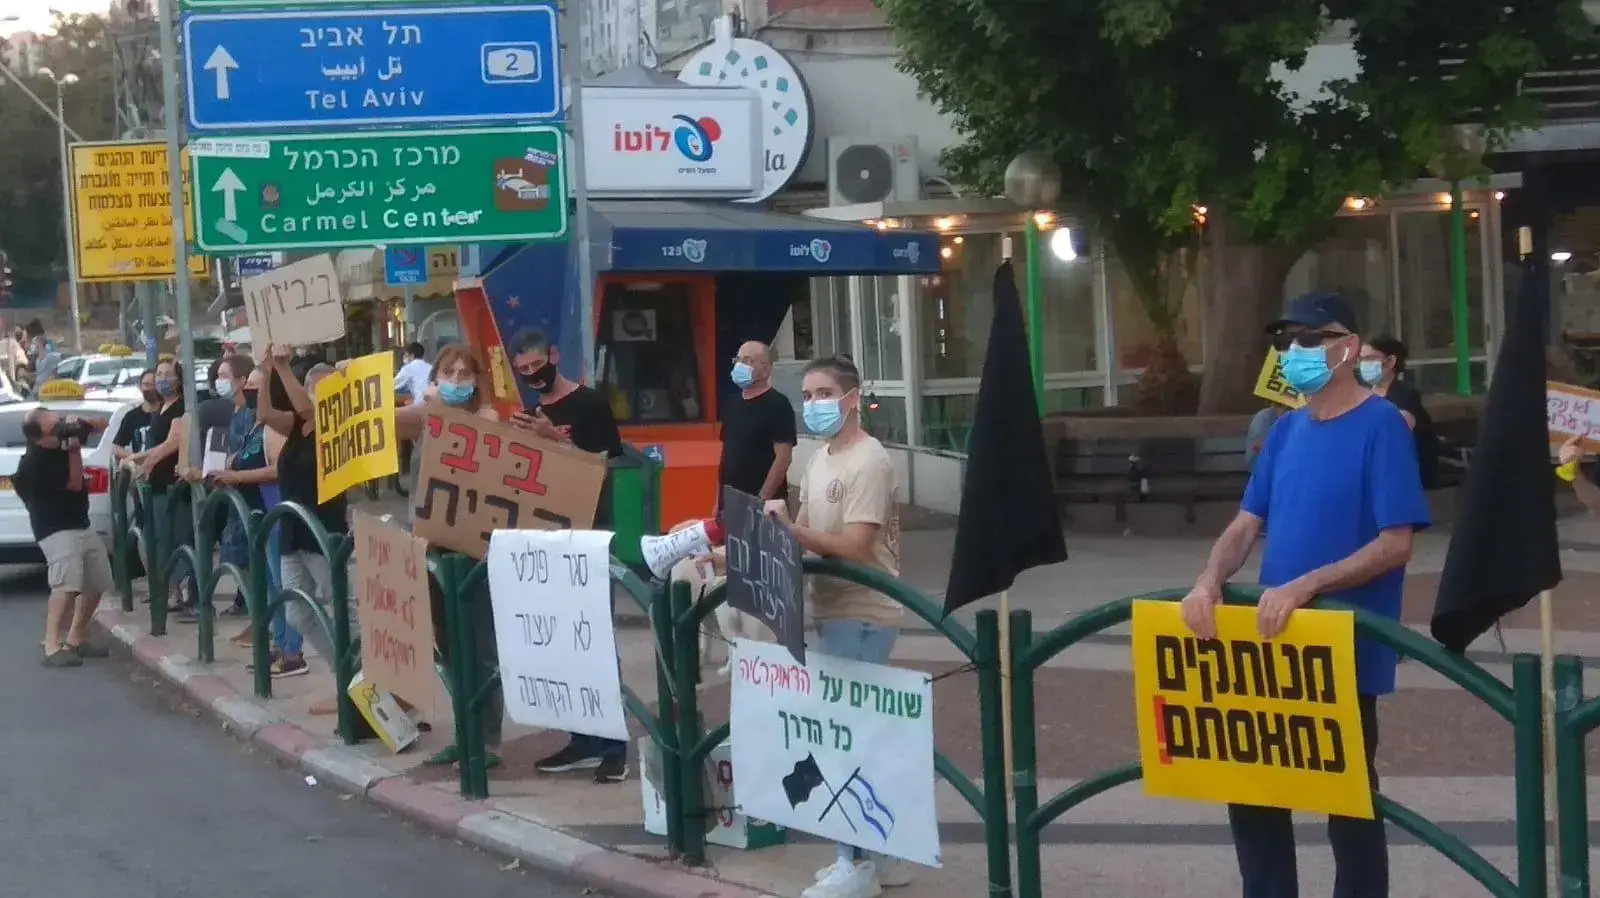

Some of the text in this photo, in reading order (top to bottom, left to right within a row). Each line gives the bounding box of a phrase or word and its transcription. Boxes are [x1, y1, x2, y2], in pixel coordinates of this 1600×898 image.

[300, 20, 422, 48] תל אביב
[377, 55, 403, 81] تل
[505, 53, 519, 72] 2
[305, 86, 424, 110] Tel Aviv
[614, 123, 671, 152] לוטו
[283, 146, 379, 171] הכרמל
[392, 144, 461, 167] מרכז
[306, 177, 437, 206] مركز الكرمل
[261, 207, 483, 234] Carmel Center
[562, 553, 589, 587] סגר
[514, 609, 592, 652] לא יעצור
[1155, 634, 1338, 705] מנותקים
[517, 675, 605, 719] את הקורונה
[738, 656, 923, 720] שומרים על הדמוקרטיה
[777, 709, 852, 753] כל הדרך
[1152, 694, 1346, 774] נמאסתם!
